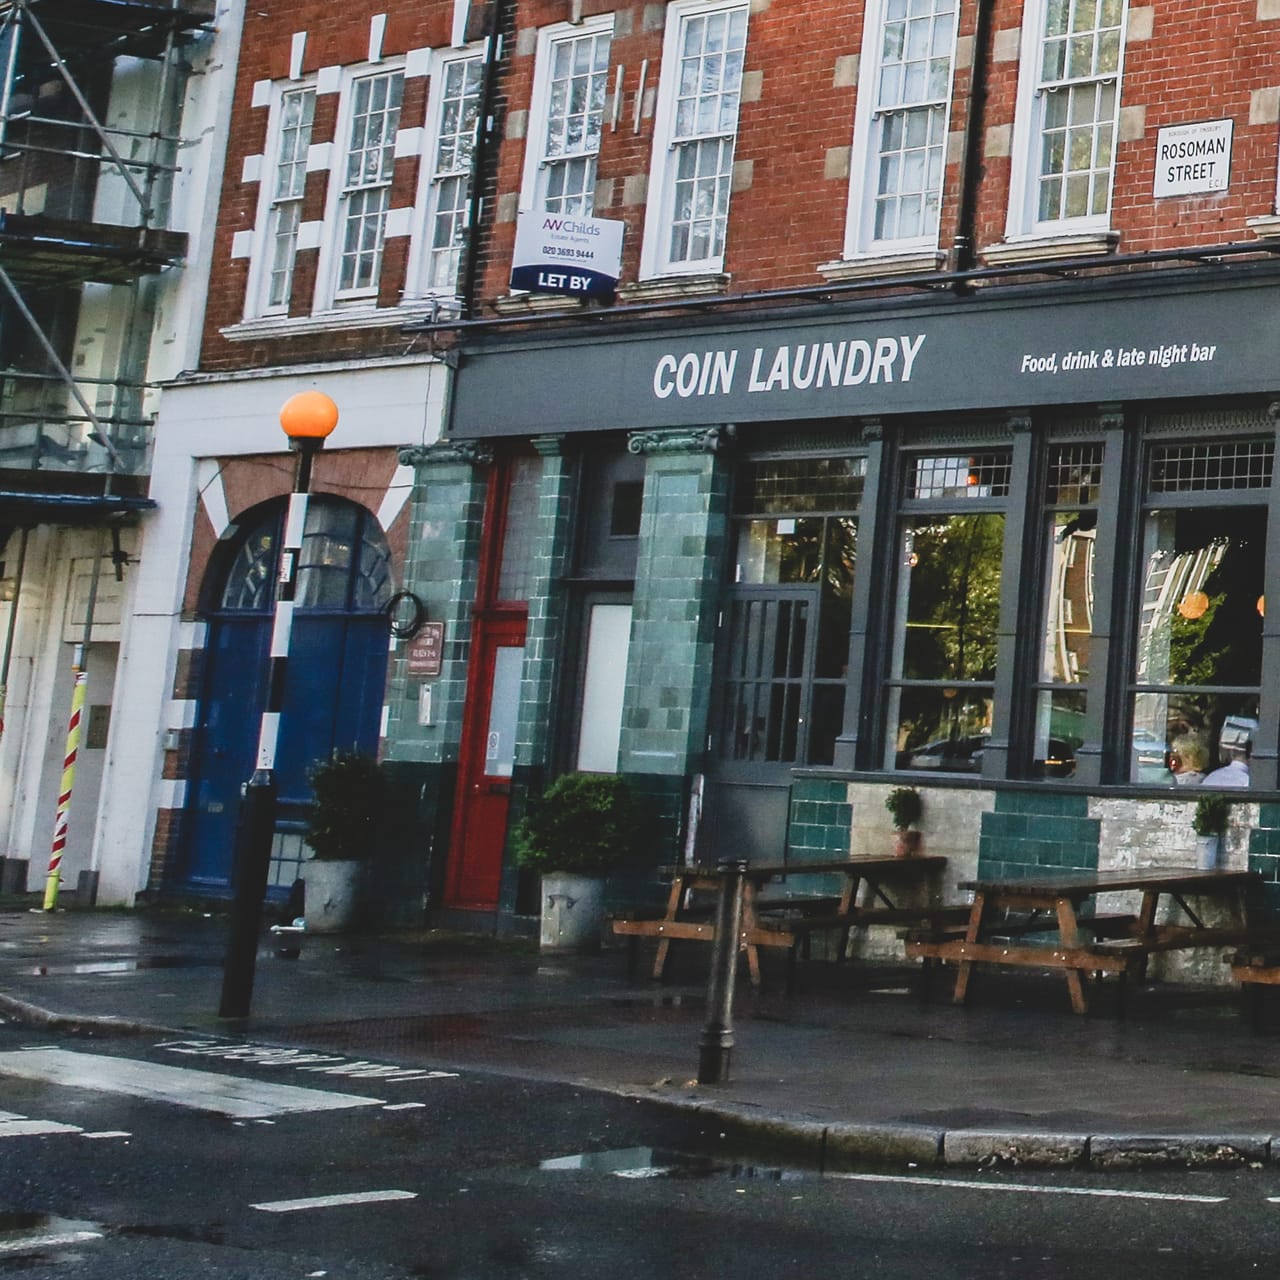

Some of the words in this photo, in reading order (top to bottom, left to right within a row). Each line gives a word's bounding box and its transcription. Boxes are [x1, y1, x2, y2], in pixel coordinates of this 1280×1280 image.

[1161, 137, 1226, 160] ROSOMAN
[1167, 161, 1216, 183] STREET
[538, 272, 568, 288] LET
[569, 275, 592, 290] BY
[653, 349, 737, 399] COIN
[747, 334, 926, 392] LAUNDRY
[1020, 352, 1058, 374] Food,
[1062, 350, 1100, 370] drink
[1101, 349, 1115, 368] &
[1116, 347, 1145, 367] late
[1148, 344, 1188, 368] night
[1189, 343, 1217, 362] bar
